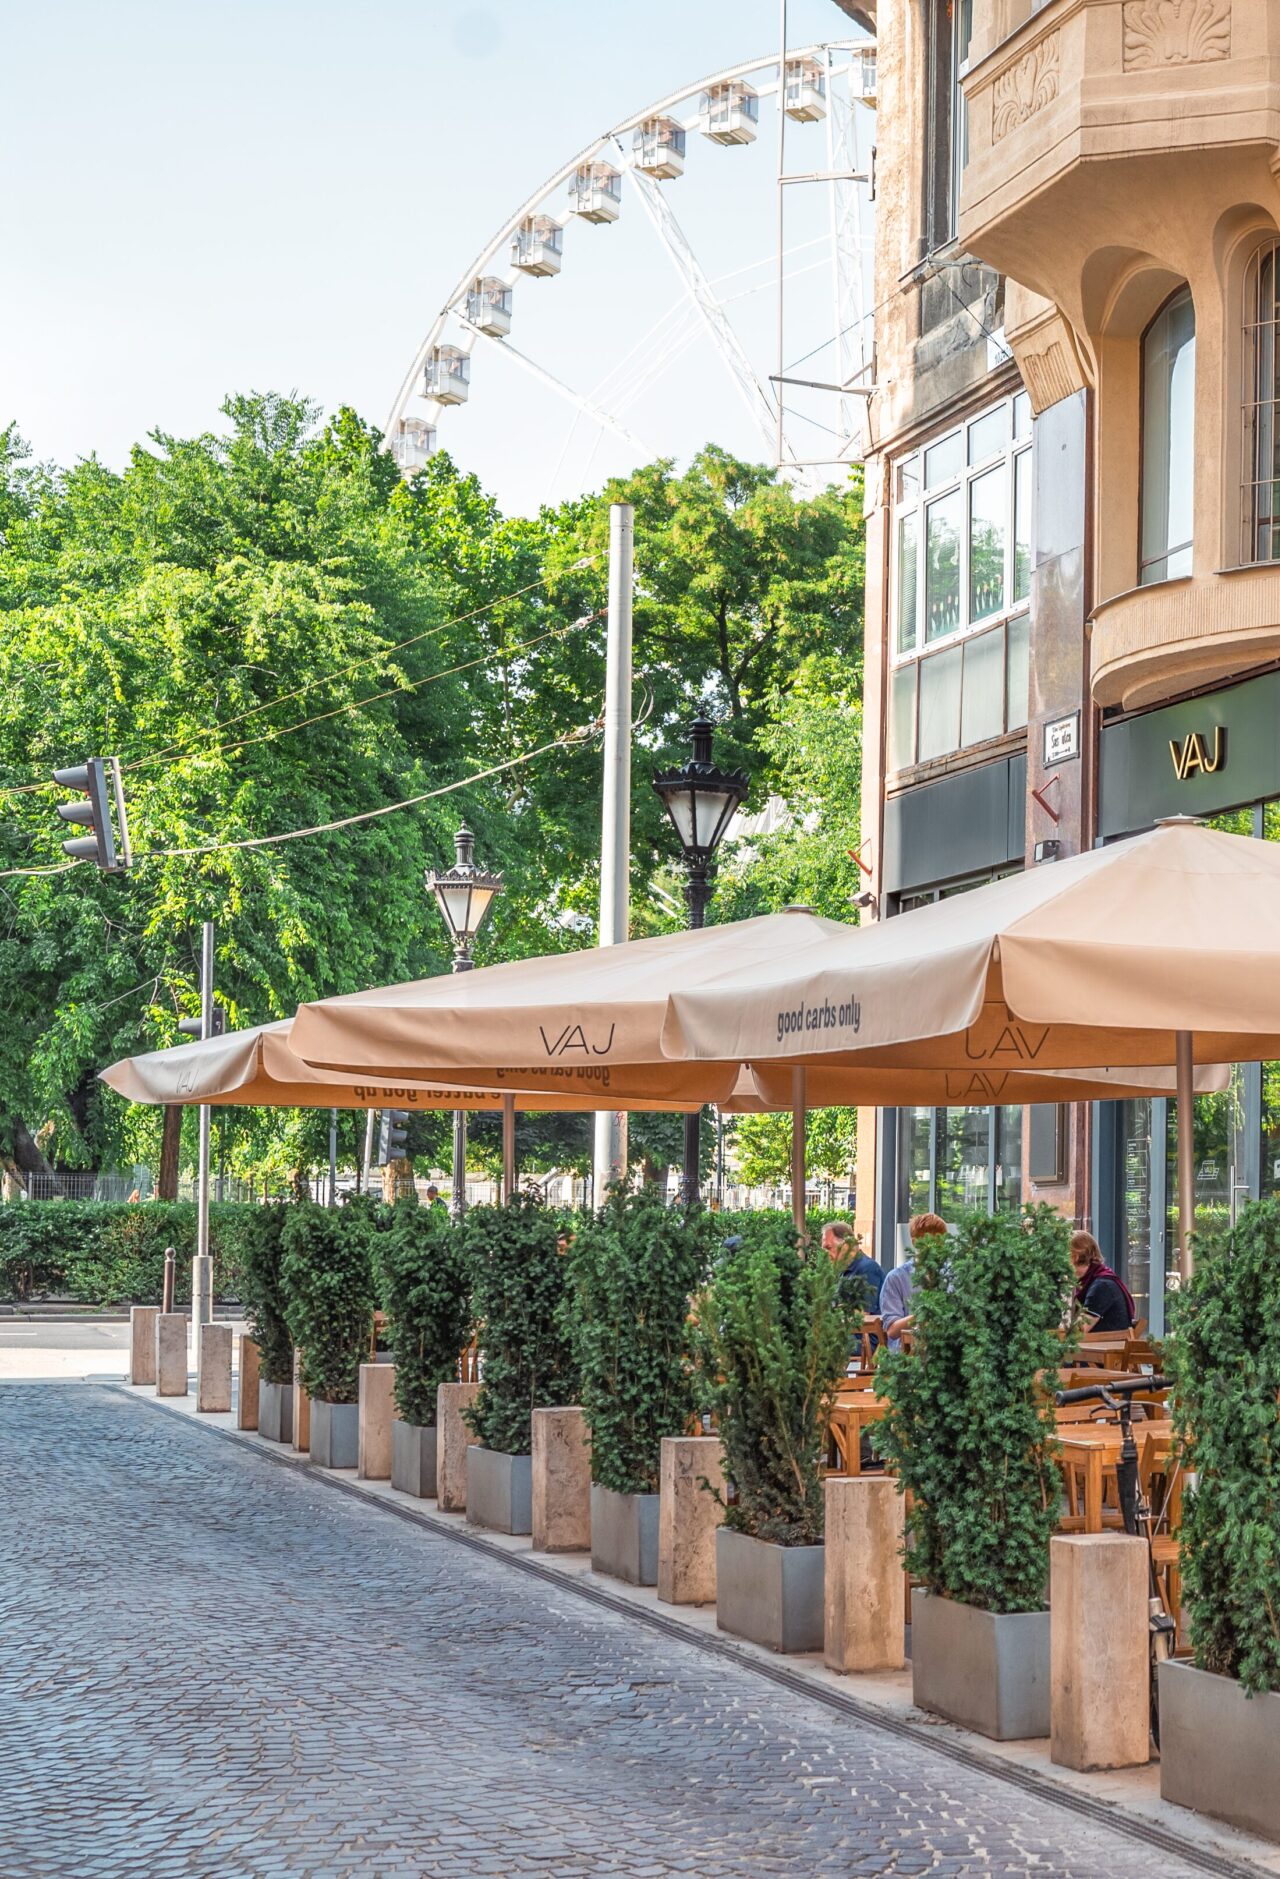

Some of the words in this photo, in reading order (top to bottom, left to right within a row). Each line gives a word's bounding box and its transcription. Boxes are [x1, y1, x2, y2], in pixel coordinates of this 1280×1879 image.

[1169, 725, 1222, 780] VAJ
[539, 1022, 615, 1056] VAJ
[777, 1001, 804, 1042] good
[806, 997, 836, 1030] carbs
[839, 993, 861, 1034] only
